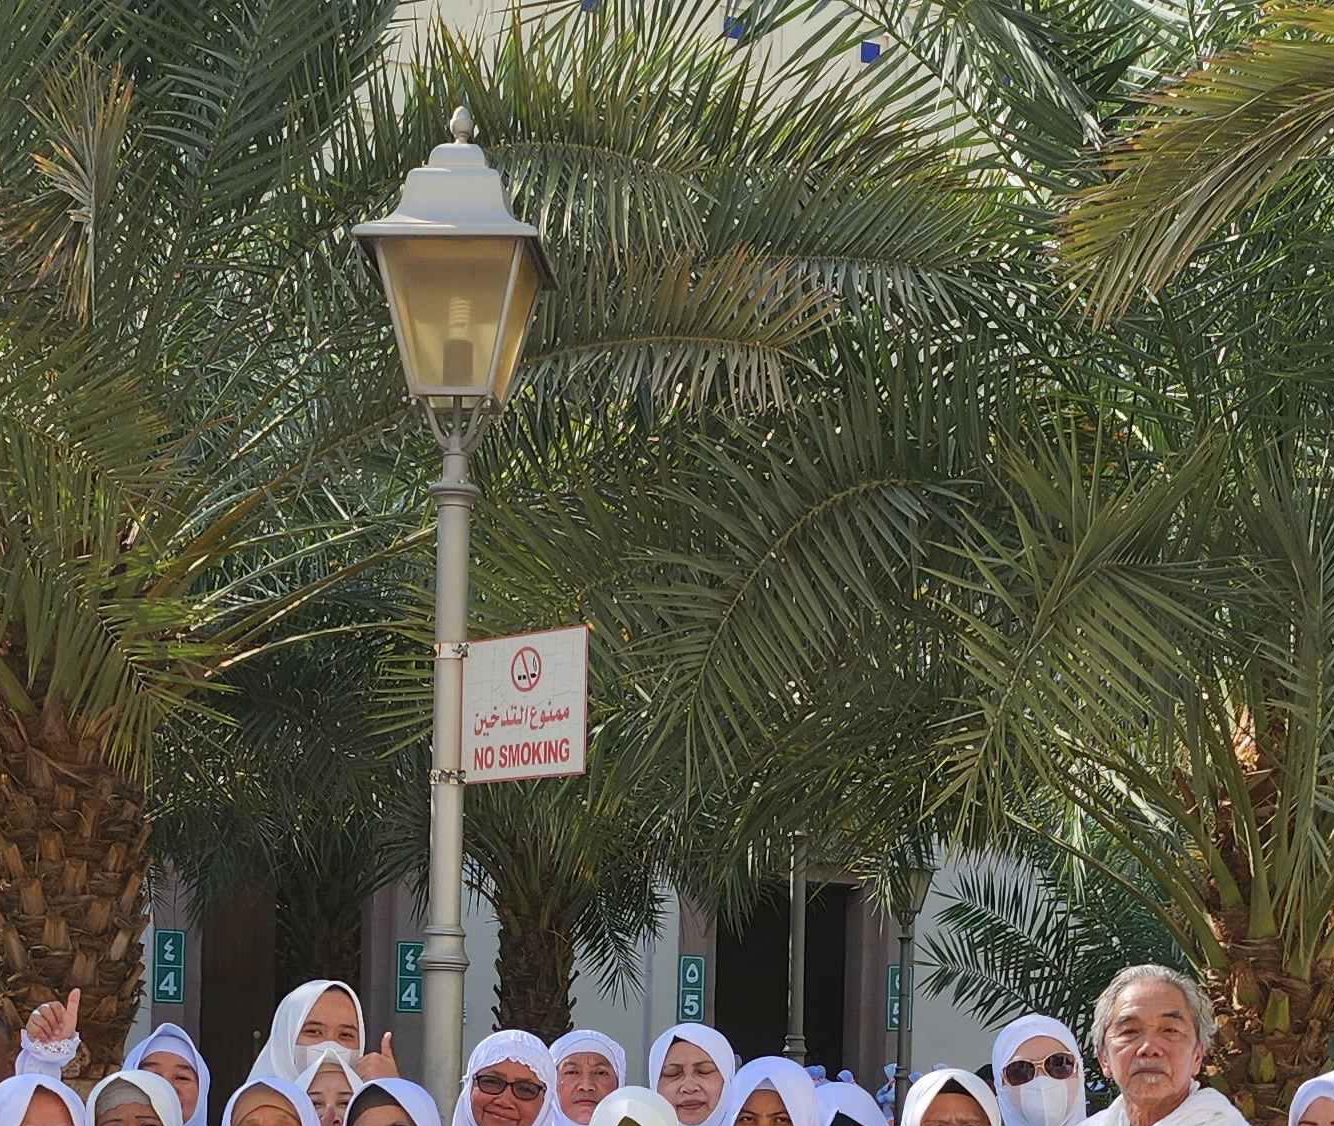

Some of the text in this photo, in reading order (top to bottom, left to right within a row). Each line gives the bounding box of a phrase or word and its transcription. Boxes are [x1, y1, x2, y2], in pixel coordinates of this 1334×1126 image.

[473, 700, 571, 737] ممنوع التدخين
[474, 737, 571, 771] NO SMOKING
[158, 972, 177, 996] 4
[401, 981, 419, 1006] 4
[683, 994, 699, 1017] 5
